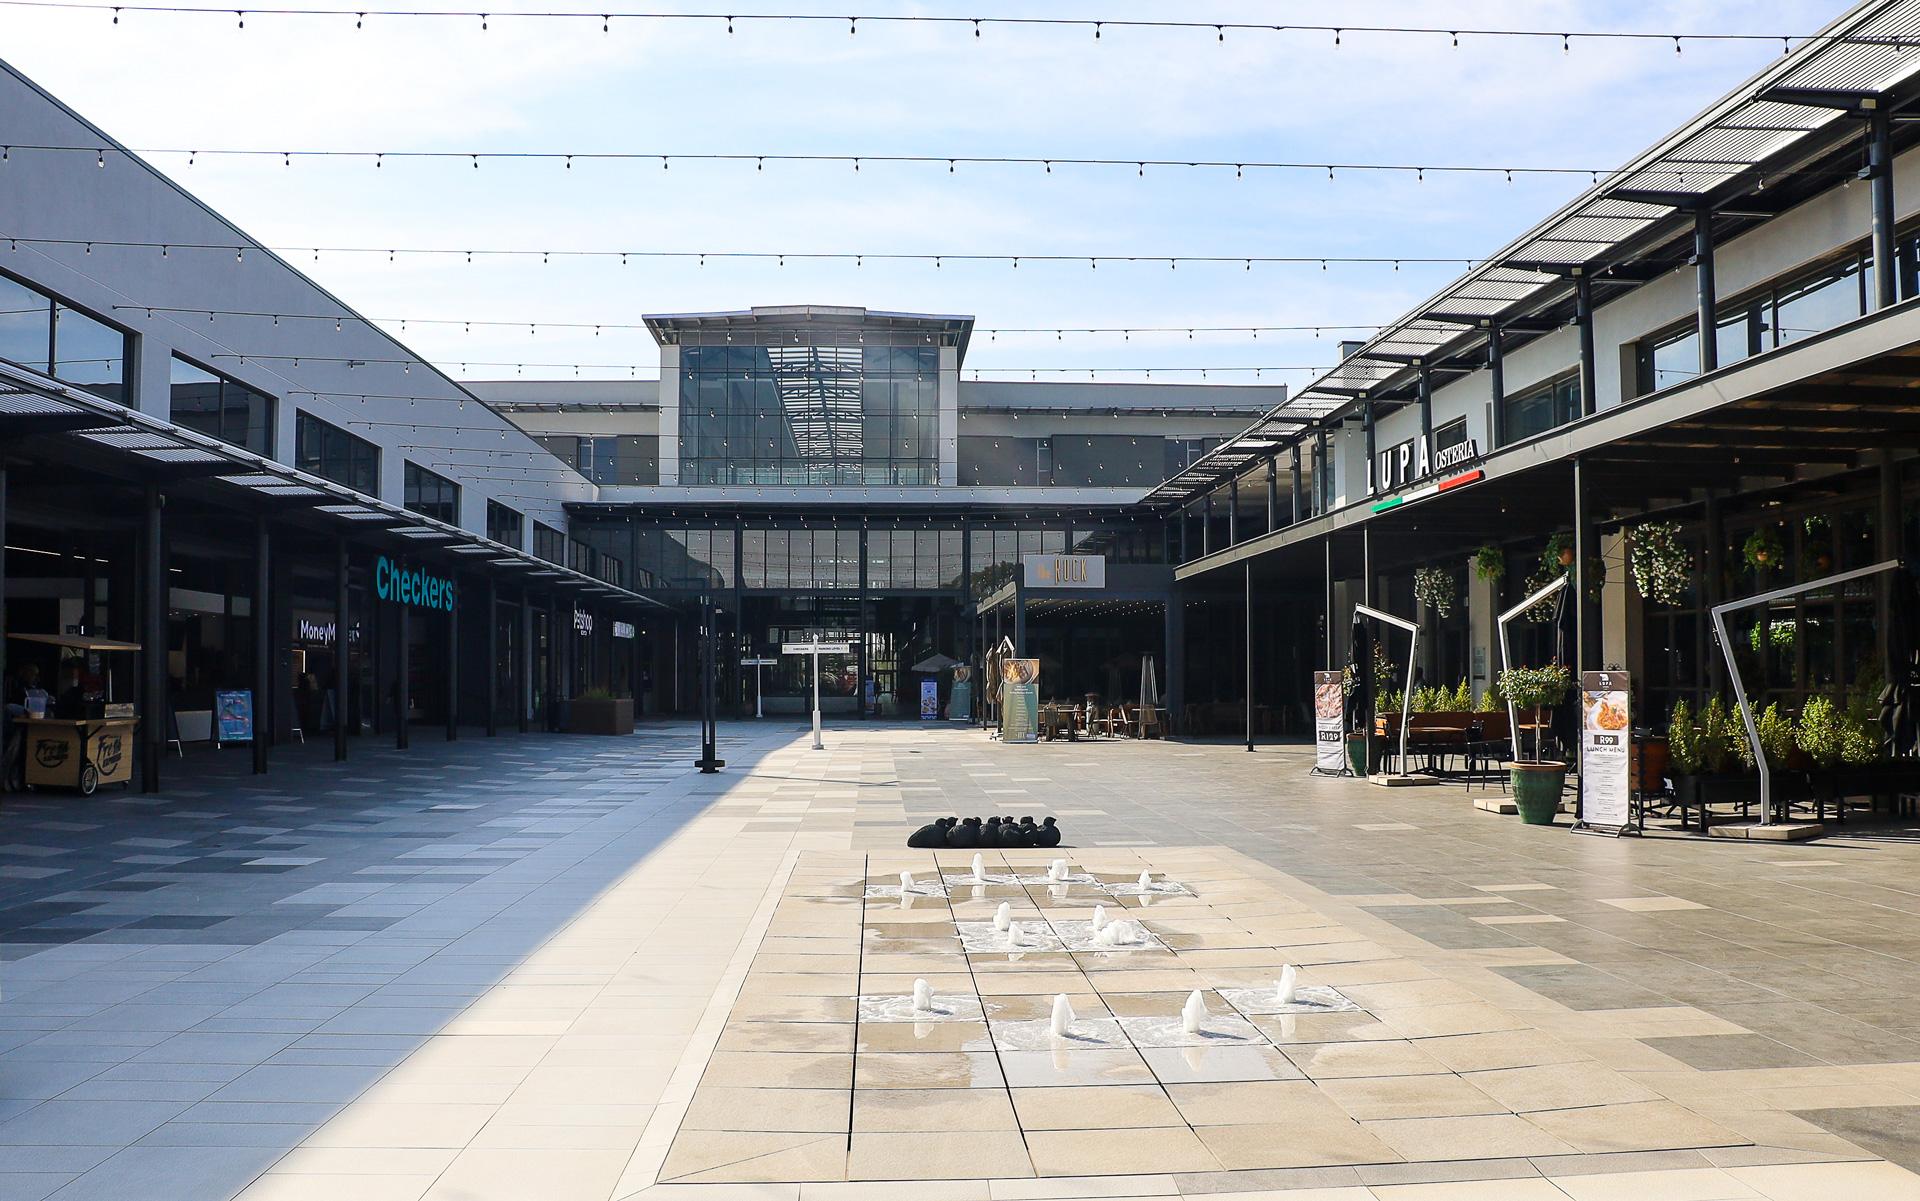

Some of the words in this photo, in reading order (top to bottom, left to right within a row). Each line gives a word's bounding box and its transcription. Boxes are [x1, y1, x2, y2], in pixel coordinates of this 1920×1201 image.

[1366, 434, 1430, 496] LUPA
[1434, 437, 1475, 470] OSTERIA
[376, 555, 453, 612] Checkers
[1055, 558, 1087, 584] ROCK
[1320, 731, 1339, 741] R129
[1599, 735, 1614, 745] R99
